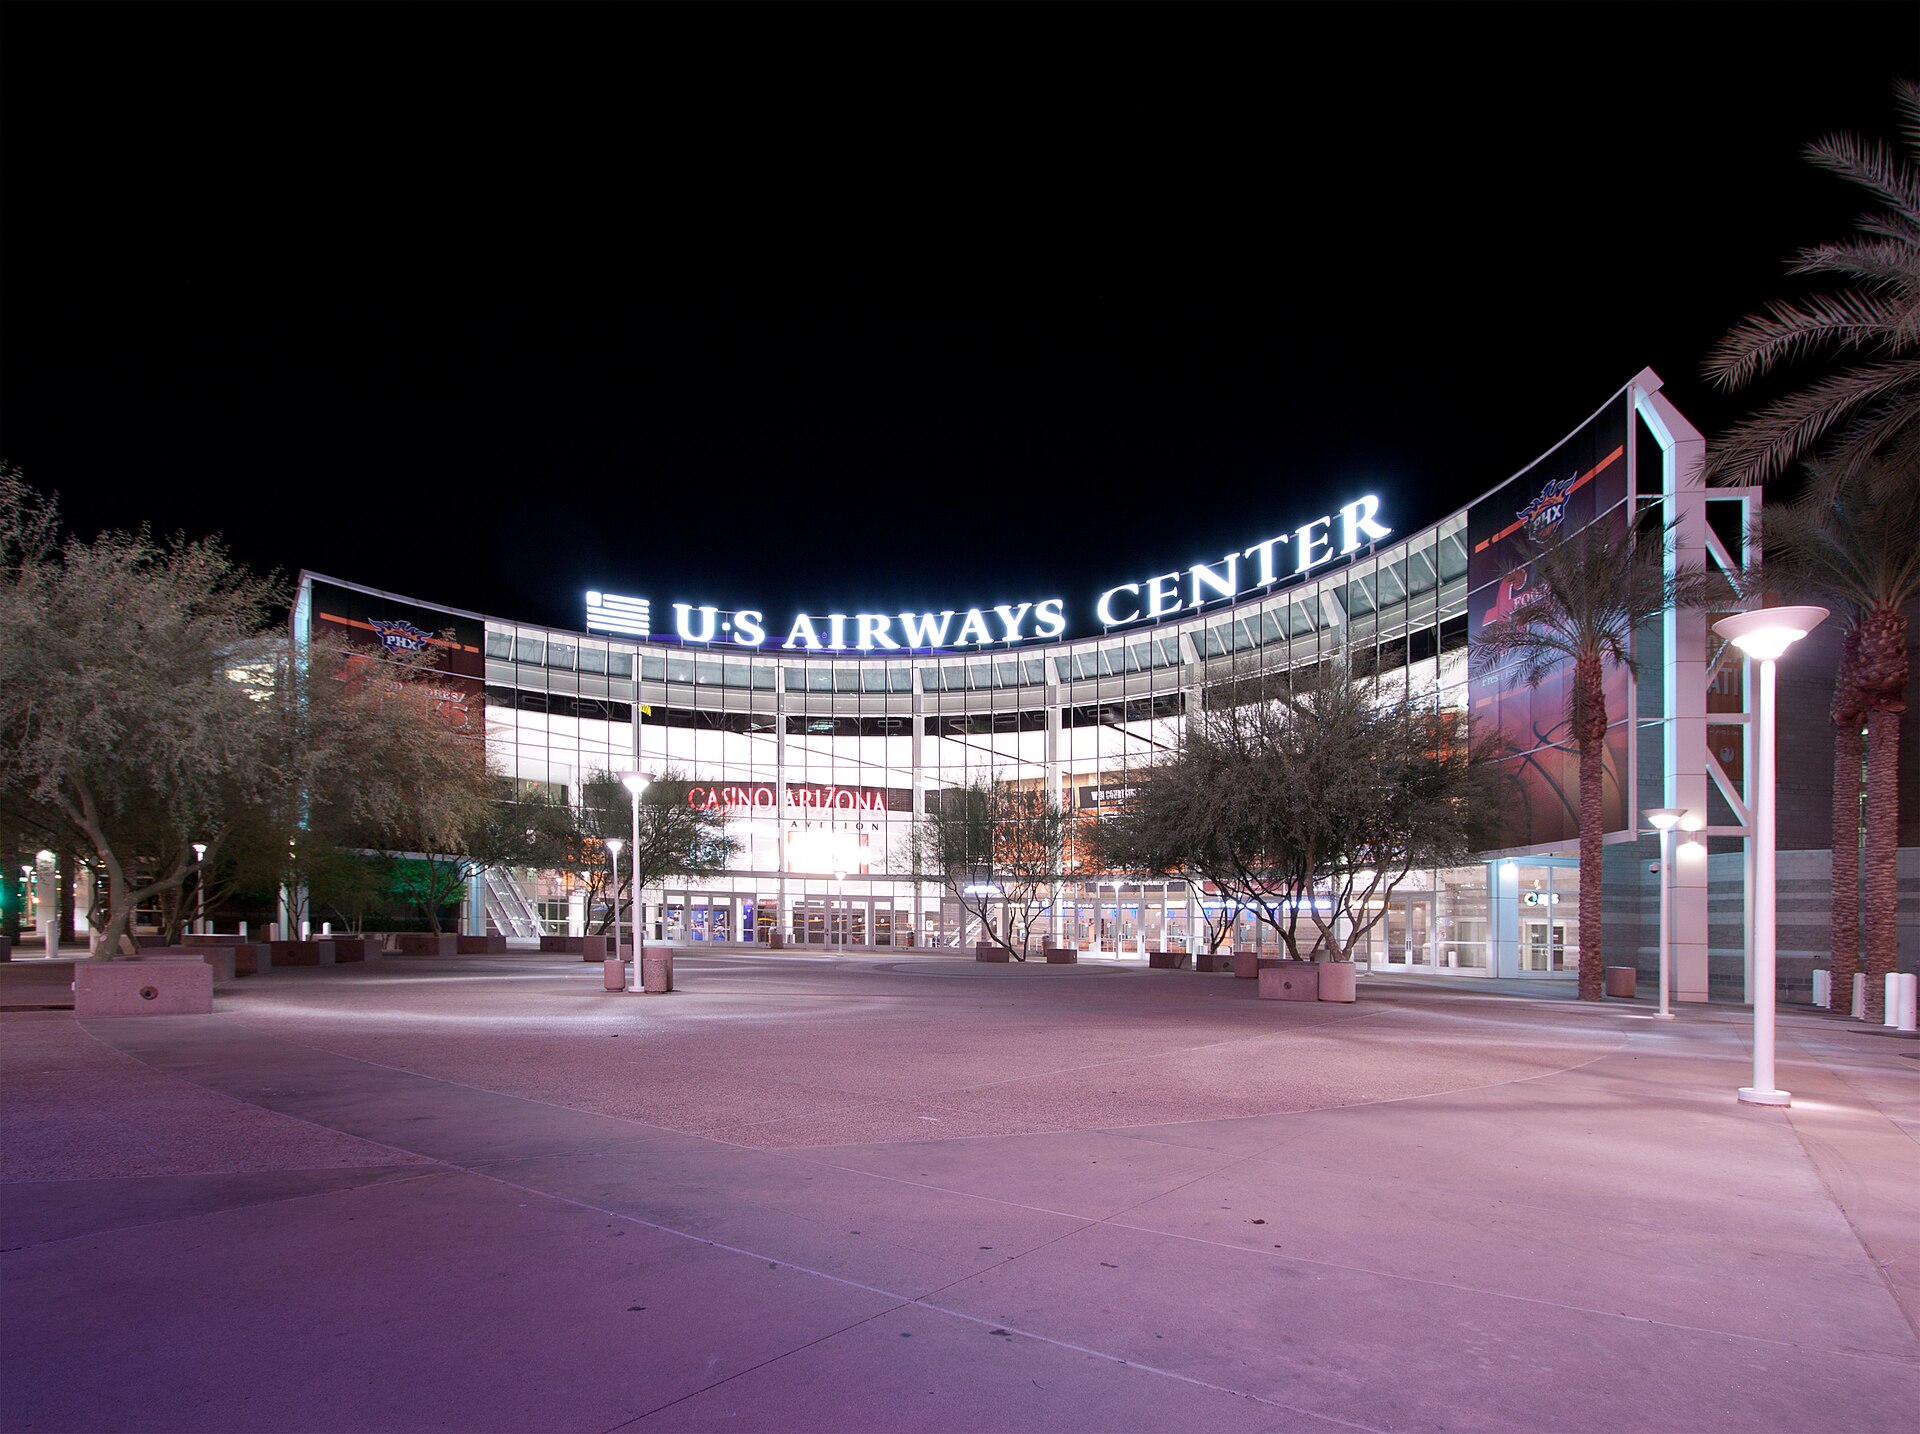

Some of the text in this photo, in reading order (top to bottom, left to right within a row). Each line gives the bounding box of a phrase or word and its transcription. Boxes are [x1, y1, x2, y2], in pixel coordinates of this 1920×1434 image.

[1532, 504, 1563, 533] PHX
[781, 599, 1066, 650] AIRWAYS
[1097, 494, 1393, 626] CENTER
[386, 635, 418, 651] PHX
[687, 786, 888, 817] CASINO ARIZONA
